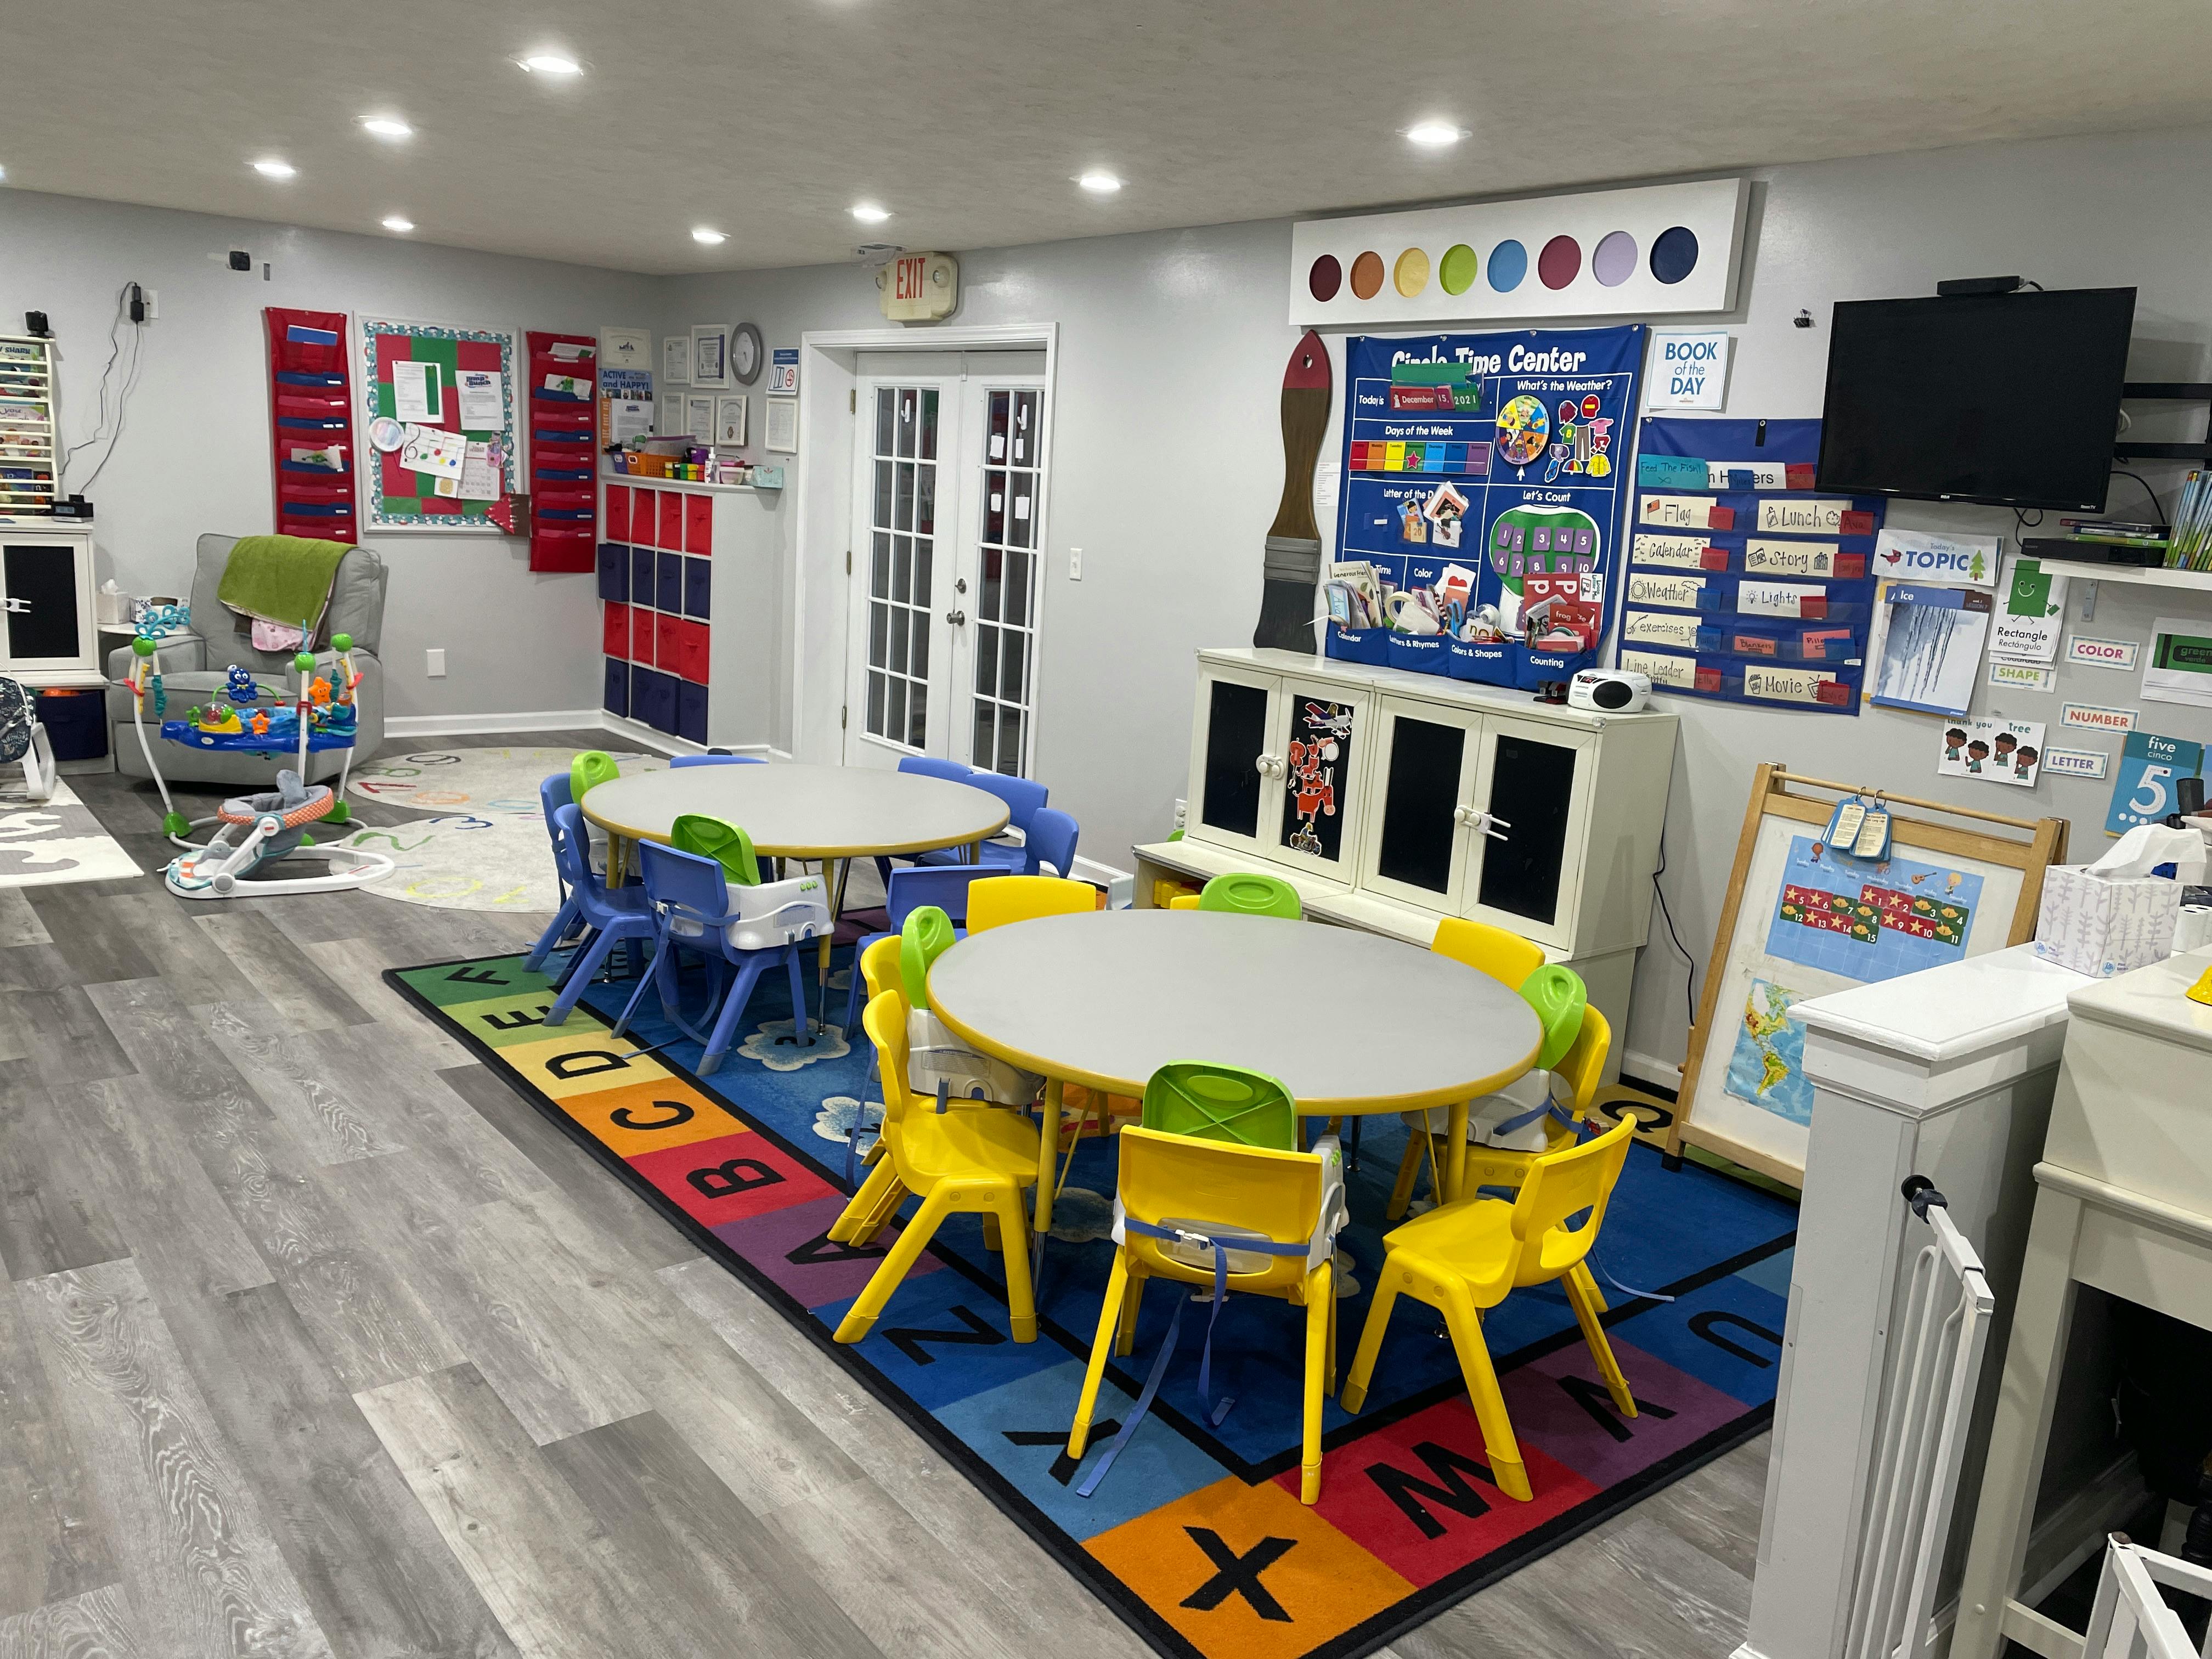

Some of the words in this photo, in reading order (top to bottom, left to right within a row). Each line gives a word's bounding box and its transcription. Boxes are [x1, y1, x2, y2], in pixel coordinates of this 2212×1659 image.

[896, 258, 926, 299] EXIT
[1666, 342, 1718, 360] BOOK
[1509, 345, 1586, 373] Center
[1675, 361, 1687, 375] of
[1689, 362, 1705, 375] the
[603, 371, 626, 379] ACTIVE
[620, 381, 648, 390] HAPPY!
[1517, 380, 1548, 391] What's
[1550, 380, 1565, 391] the
[1566, 380, 1612, 391] Weather?
[1671, 377, 1706, 394] DAY
[1359, 395, 1379, 407] Today
[1379, 396, 1384, 405] is
[1402, 396, 1434, 404] December
[1454, 394, 1476, 405] 2021
[1385, 426, 1404, 437] Days
[1406, 426, 1415, 435] of
[1416, 426, 1429, 435] the
[1431, 426, 1453, 436] Week
[1566, 429, 1572, 438] 8
[1641, 462, 1657, 474] Feed
[1661, 462, 1677, 472] The
[1384, 489, 1402, 498] Letter
[1404, 489, 1413, 498] of
[1415, 489, 1426, 499] the
[1523, 490, 1543, 500] Let's
[1545, 491, 1571, 502] Count
[1665, 504, 1691, 526] Flag
[1782, 505, 1821, 527] Lunch
[1844, 517, 1863, 529] Ava
[1503, 530, 1507, 539] 1
[1517, 535, 1521, 544] 2
[1539, 534, 1545, 543] 3
[1560, 534, 1567, 544] 4
[1580, 537, 1587, 545] 5
[1649, 542, 1692, 558] Calendar
[1499, 557, 1504, 566] 6
[1516, 561, 1521, 569] 7
[1534, 562, 1540, 571] 8
[1770, 551, 1808, 573] Story
[1906, 551, 1968, 571] TOPIC
[1414, 568, 1433, 578] Color
[1561, 563, 1567, 573] 9
[1579, 563, 1589, 573] 10
[1647, 582, 1689, 602] Weather
[1900, 590, 1914, 601] Ice
[1762, 591, 1797, 607] Lights
[1556, 611, 1571, 622] frog
[1640, 623, 1684, 635] exercises
[1997, 627, 2047, 642] Rectangle
[1338, 631, 1362, 642] Calendar
[1390, 635, 1405, 647] Letters
[1412, 640, 1440, 650] Rhymes
[1740, 639, 1771, 649] Blankets
[1999, 639, 2041, 651] Rectángulo
[1451, 644, 1467, 656] Colors
[1475, 650, 1502, 659] Shapes
[2078, 644, 2123, 659] COLOR
[2180, 647, 2212, 657] green
[1530, 656, 1564, 668] Counting
[1626, 658, 1648, 674] Line
[1654, 661, 1684, 679] Leader
[1999, 668, 2040, 681] SHAPE
[1765, 675, 1802, 694] Movie
[2070, 710, 2128, 727] NUMBER
[2009, 722, 2031, 733] tree
[2148, 736, 2176, 753] five
[2147, 751, 2172, 761] cinco
[2052, 756, 2094, 770] LETTER
[2129, 764, 2171, 815] 5
[1878, 898, 1882, 906] 1
[1903, 904, 1909, 912] 2
[1795, 913, 1803, 922] 12
[1930, 909, 1936, 917] 3
[1818, 920, 1826, 928] 13
[1871, 916, 1877, 924] 8
[1898, 922, 1904, 930] 9
[1956, 917, 1963, 925] 4
[1843, 925, 1852, 934] 14
[1923, 928, 1933, 938] 10
[1867, 933, 1876, 942] 15
[1951, 935, 1959, 944] 11
[443, 967, 511, 985] F
[479, 1005, 552, 1030] E
[545, 1051, 632, 1080] D
[609, 1099, 695, 1131] C
[1600, 1100, 1673, 1133] Q
[685, 1158, 787, 1199] B
[784, 1232, 888, 1266] A
[881, 1305, 1007, 1366] Z
[1687, 1310, 1782, 1369] U
[1556, 1374, 1680, 1443] V
[1364, 1441, 1493, 1542] W
[1180, 1525, 1298, 1624] X
